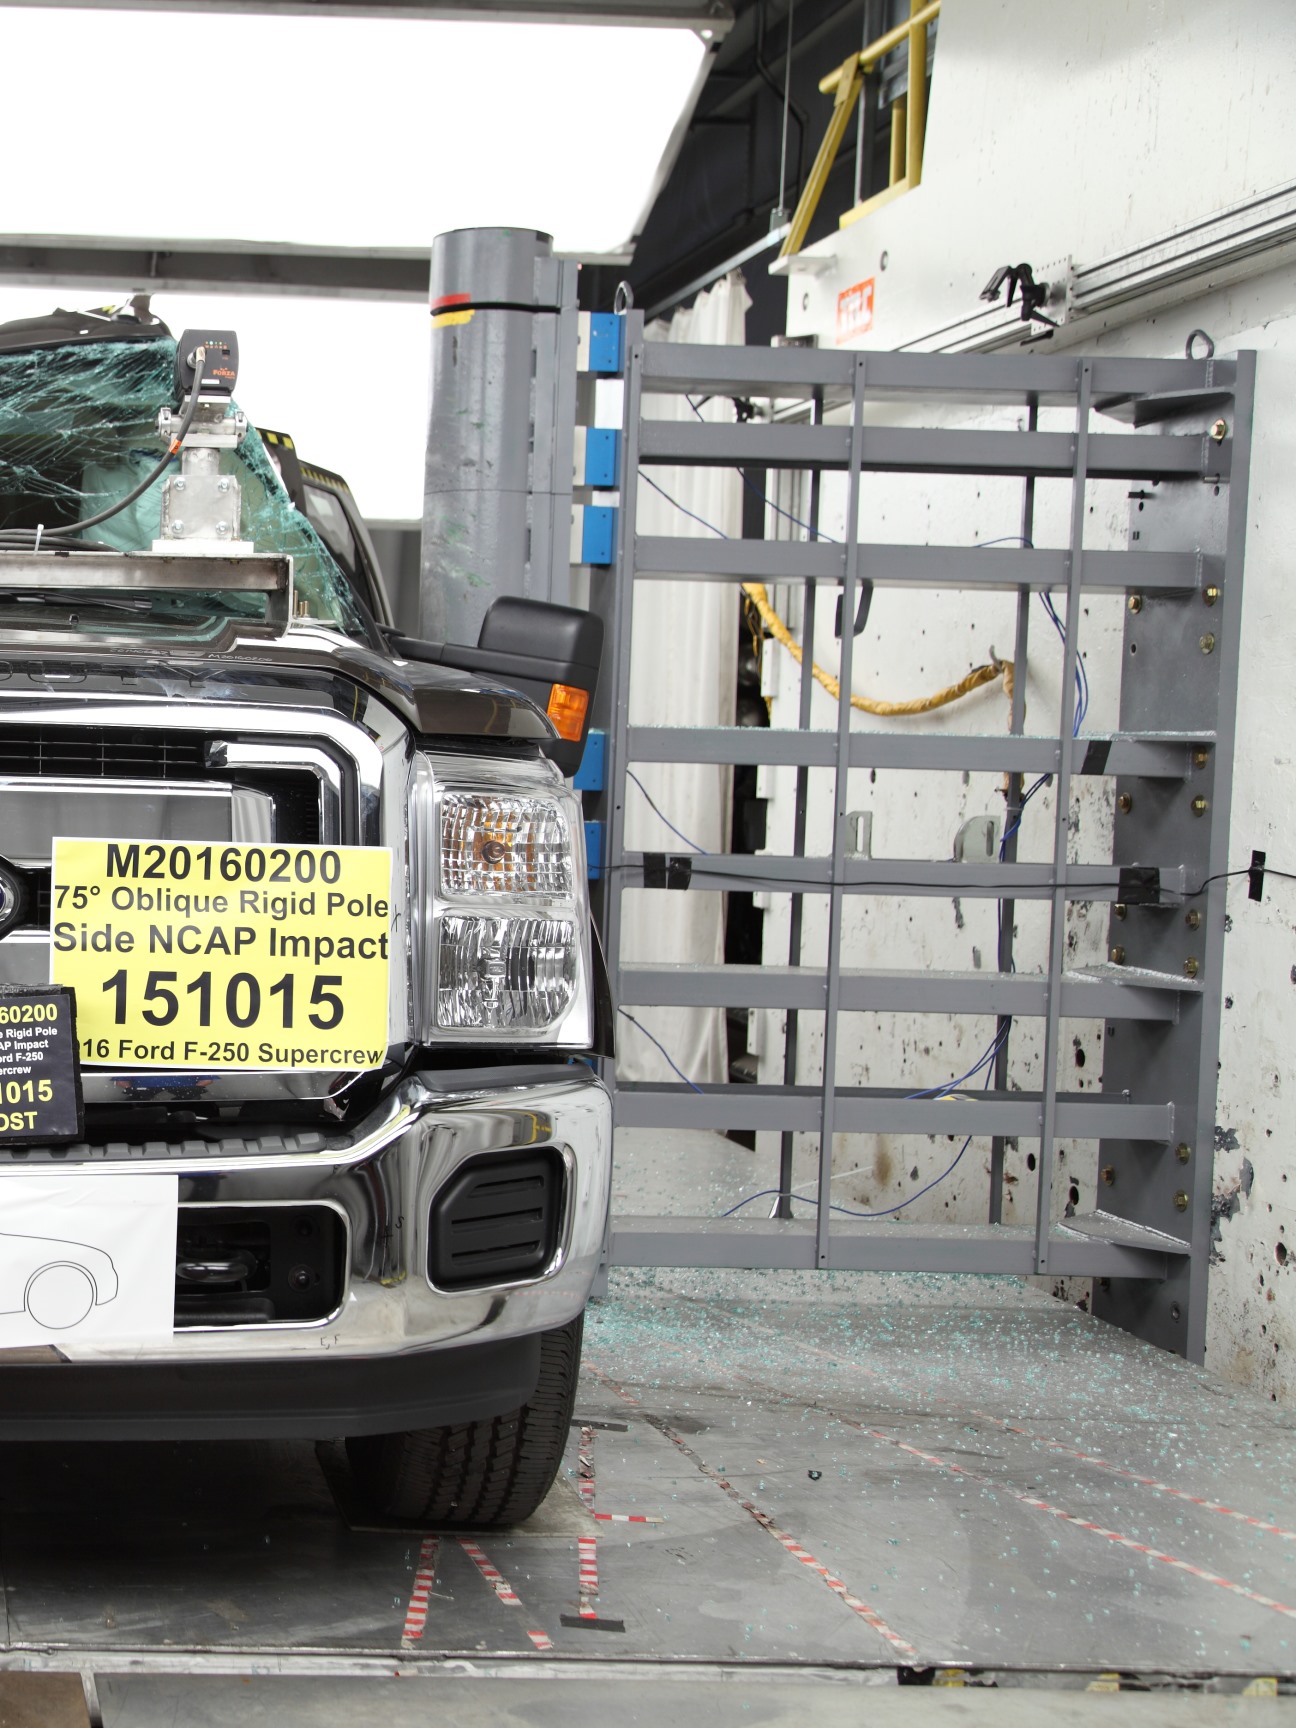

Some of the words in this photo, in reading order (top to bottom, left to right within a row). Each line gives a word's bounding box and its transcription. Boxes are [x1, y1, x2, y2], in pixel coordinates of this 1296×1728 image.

[106, 843, 342, 884] M20160200
[54, 884, 101, 910] 75°
[110, 886, 229, 919] Oblique
[239, 889, 317, 921] Rigid
[327, 892, 389, 918] Pole
[53, 922, 136, 954] Side
[149, 924, 257, 956] NCAP
[269, 927, 390, 965] Impact
[101, 968, 344, 1031] 151015
[5, 1027, 33, 1040] Rigid
[35, 1026, 58, 1037] Pole
[14, 1039, 49, 1052] Impact
[15, 1051, 44, 1063] F-250
[79, 1038, 110, 1059] 16
[117, 1039, 175, 1061] Ford
[183, 1041, 250, 1062] F-250
[257, 1042, 384, 1065] Supercrew
